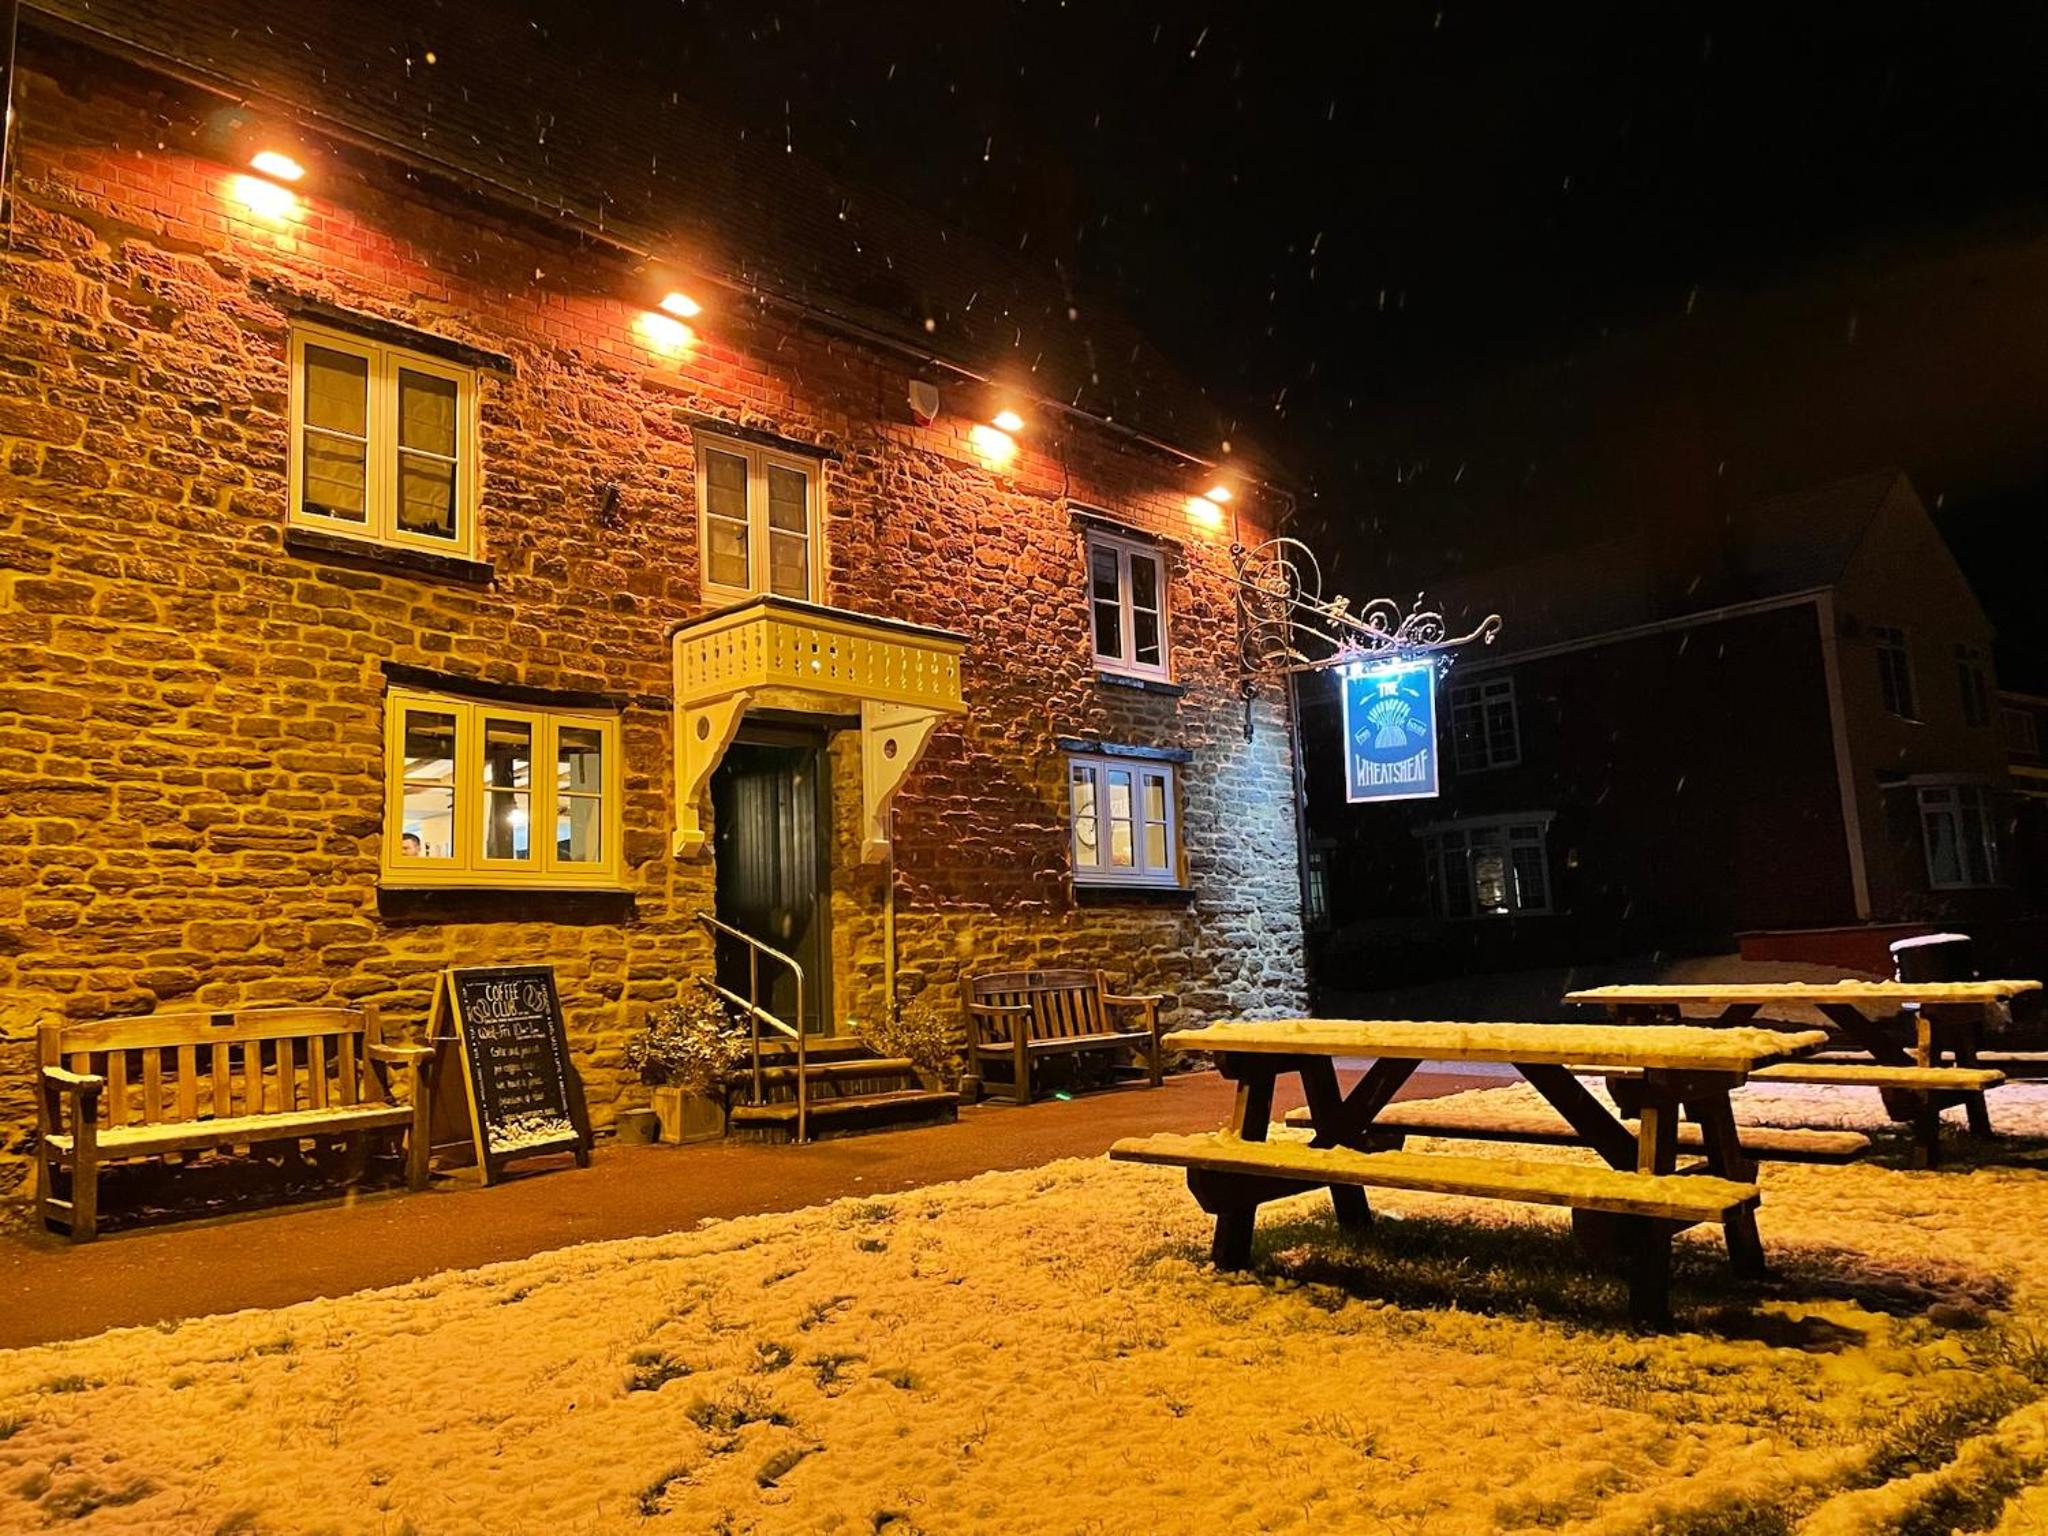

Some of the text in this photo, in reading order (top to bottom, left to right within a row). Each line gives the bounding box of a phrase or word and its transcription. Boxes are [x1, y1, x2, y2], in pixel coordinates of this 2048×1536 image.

[1377, 682, 1399, 698] THE
[1355, 748, 1428, 787] WHEATSHEAF
[486, 983, 520, 1002] COFFEE
[492, 1001, 517, 1018] CLUB
